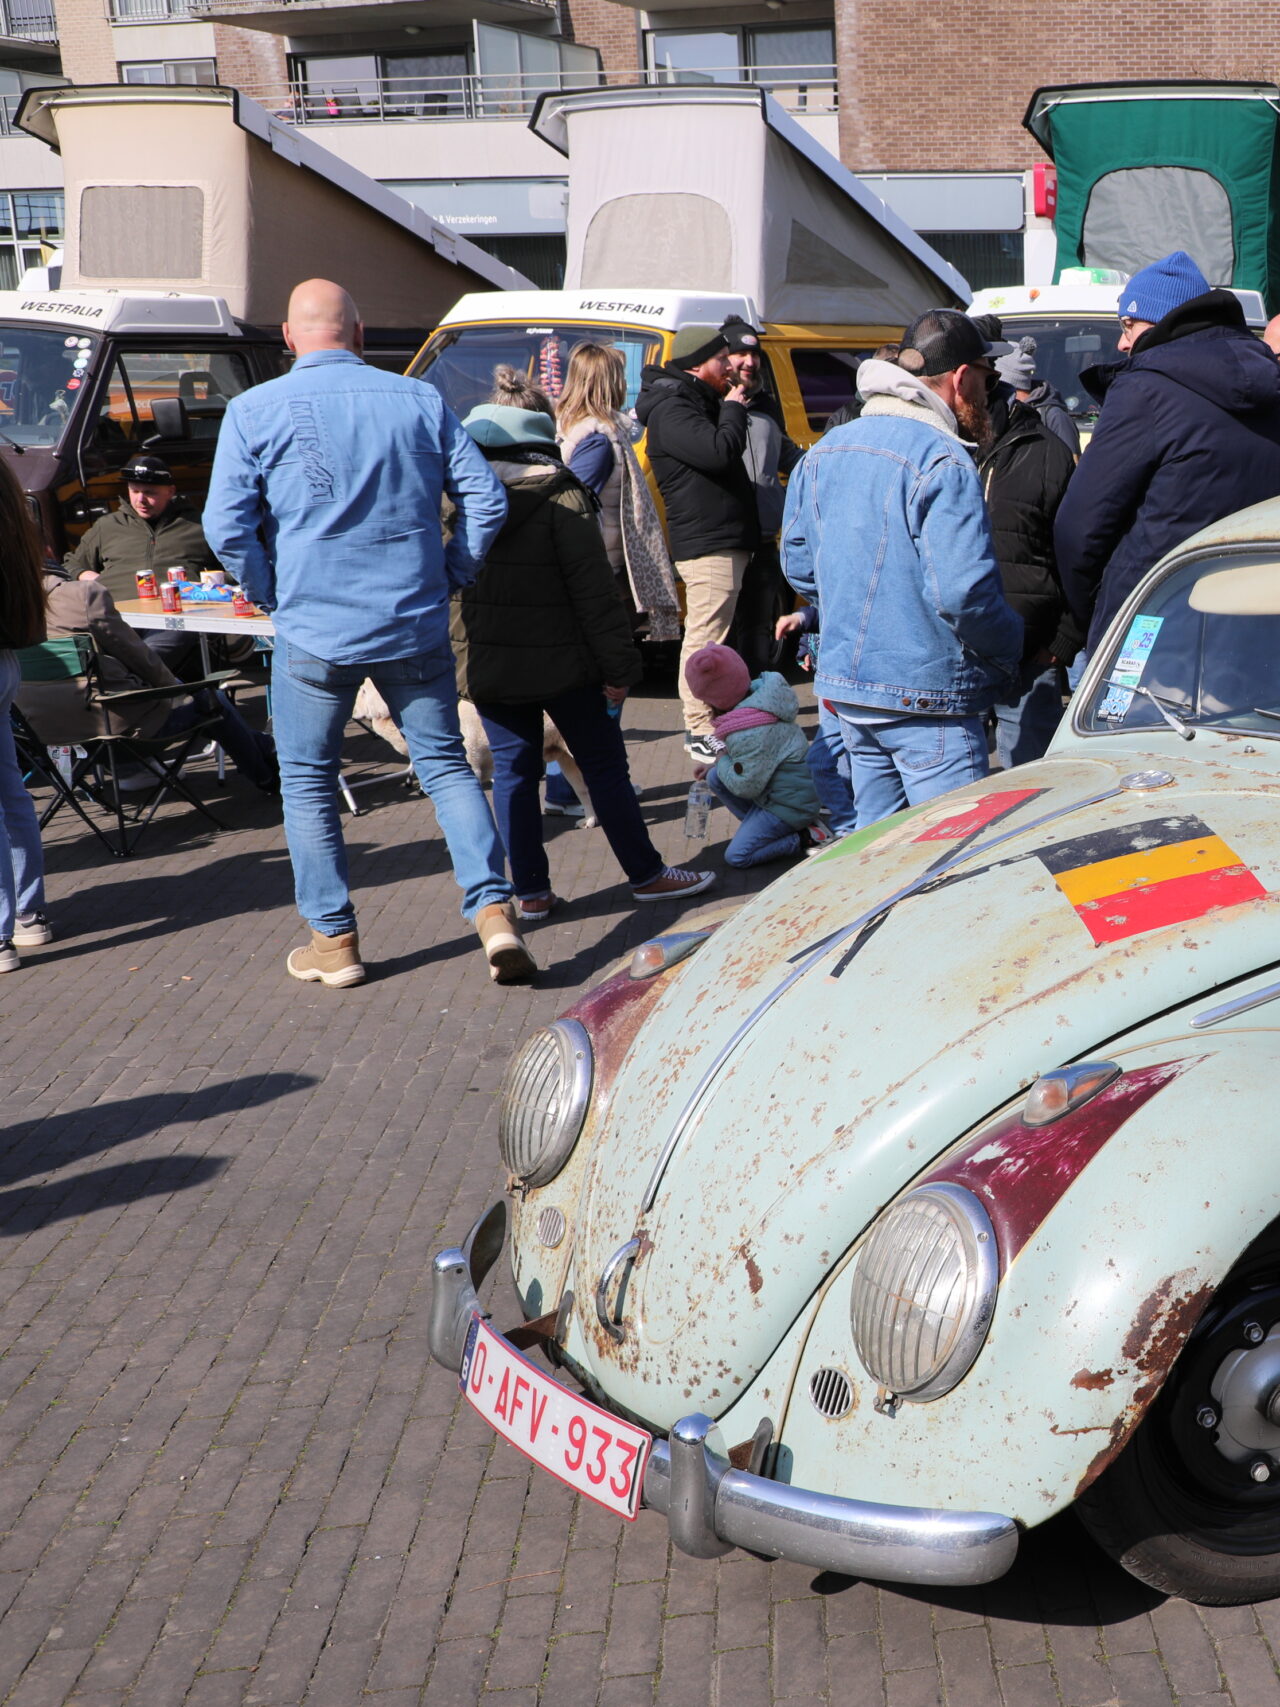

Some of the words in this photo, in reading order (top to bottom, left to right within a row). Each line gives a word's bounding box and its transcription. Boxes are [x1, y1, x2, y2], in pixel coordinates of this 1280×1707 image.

[446, 214, 497, 225] Verzekeringen
[20, 301, 103, 318] WESTFALIA
[579, 300, 665, 316] WESTFALIA
[461, 1356, 470, 1381] B
